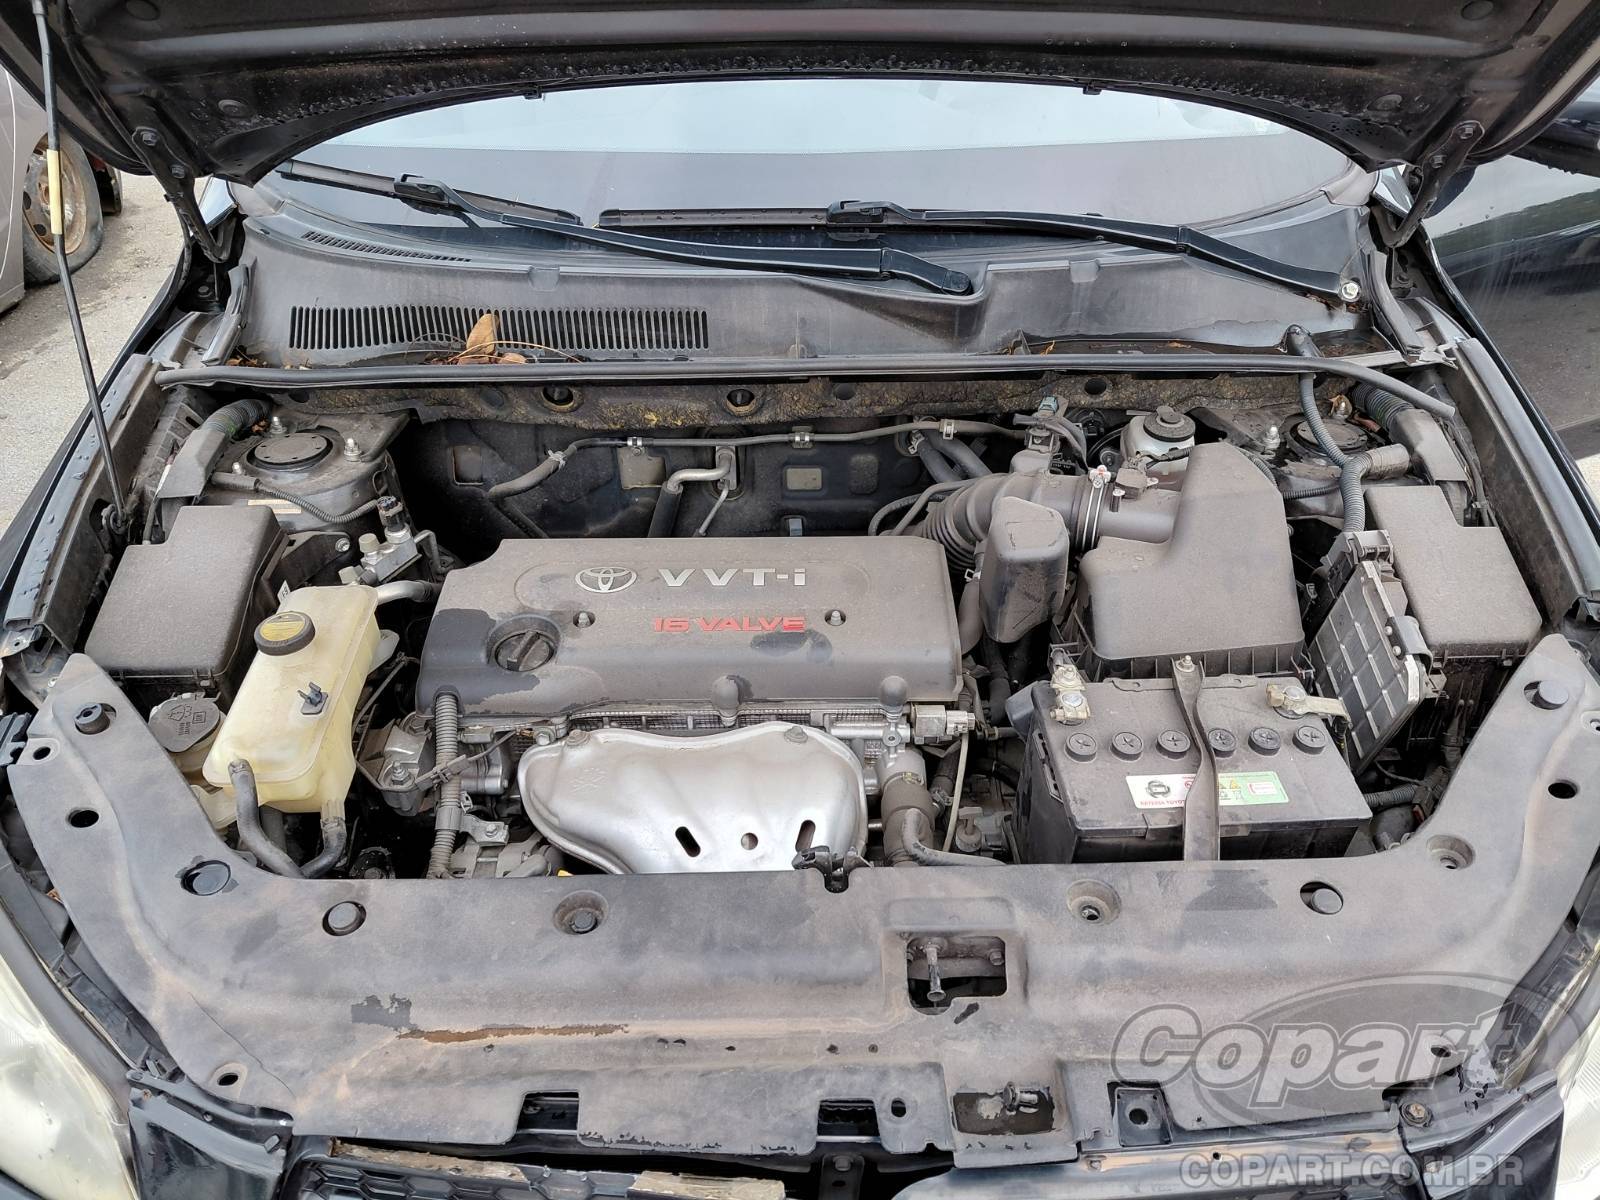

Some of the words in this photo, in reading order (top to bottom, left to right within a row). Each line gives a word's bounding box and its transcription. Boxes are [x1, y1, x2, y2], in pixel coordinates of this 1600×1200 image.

[658, 567, 806, 587] VVT-i
[654, 616, 689, 632] 16
[699, 615, 806, 632] VALVE
